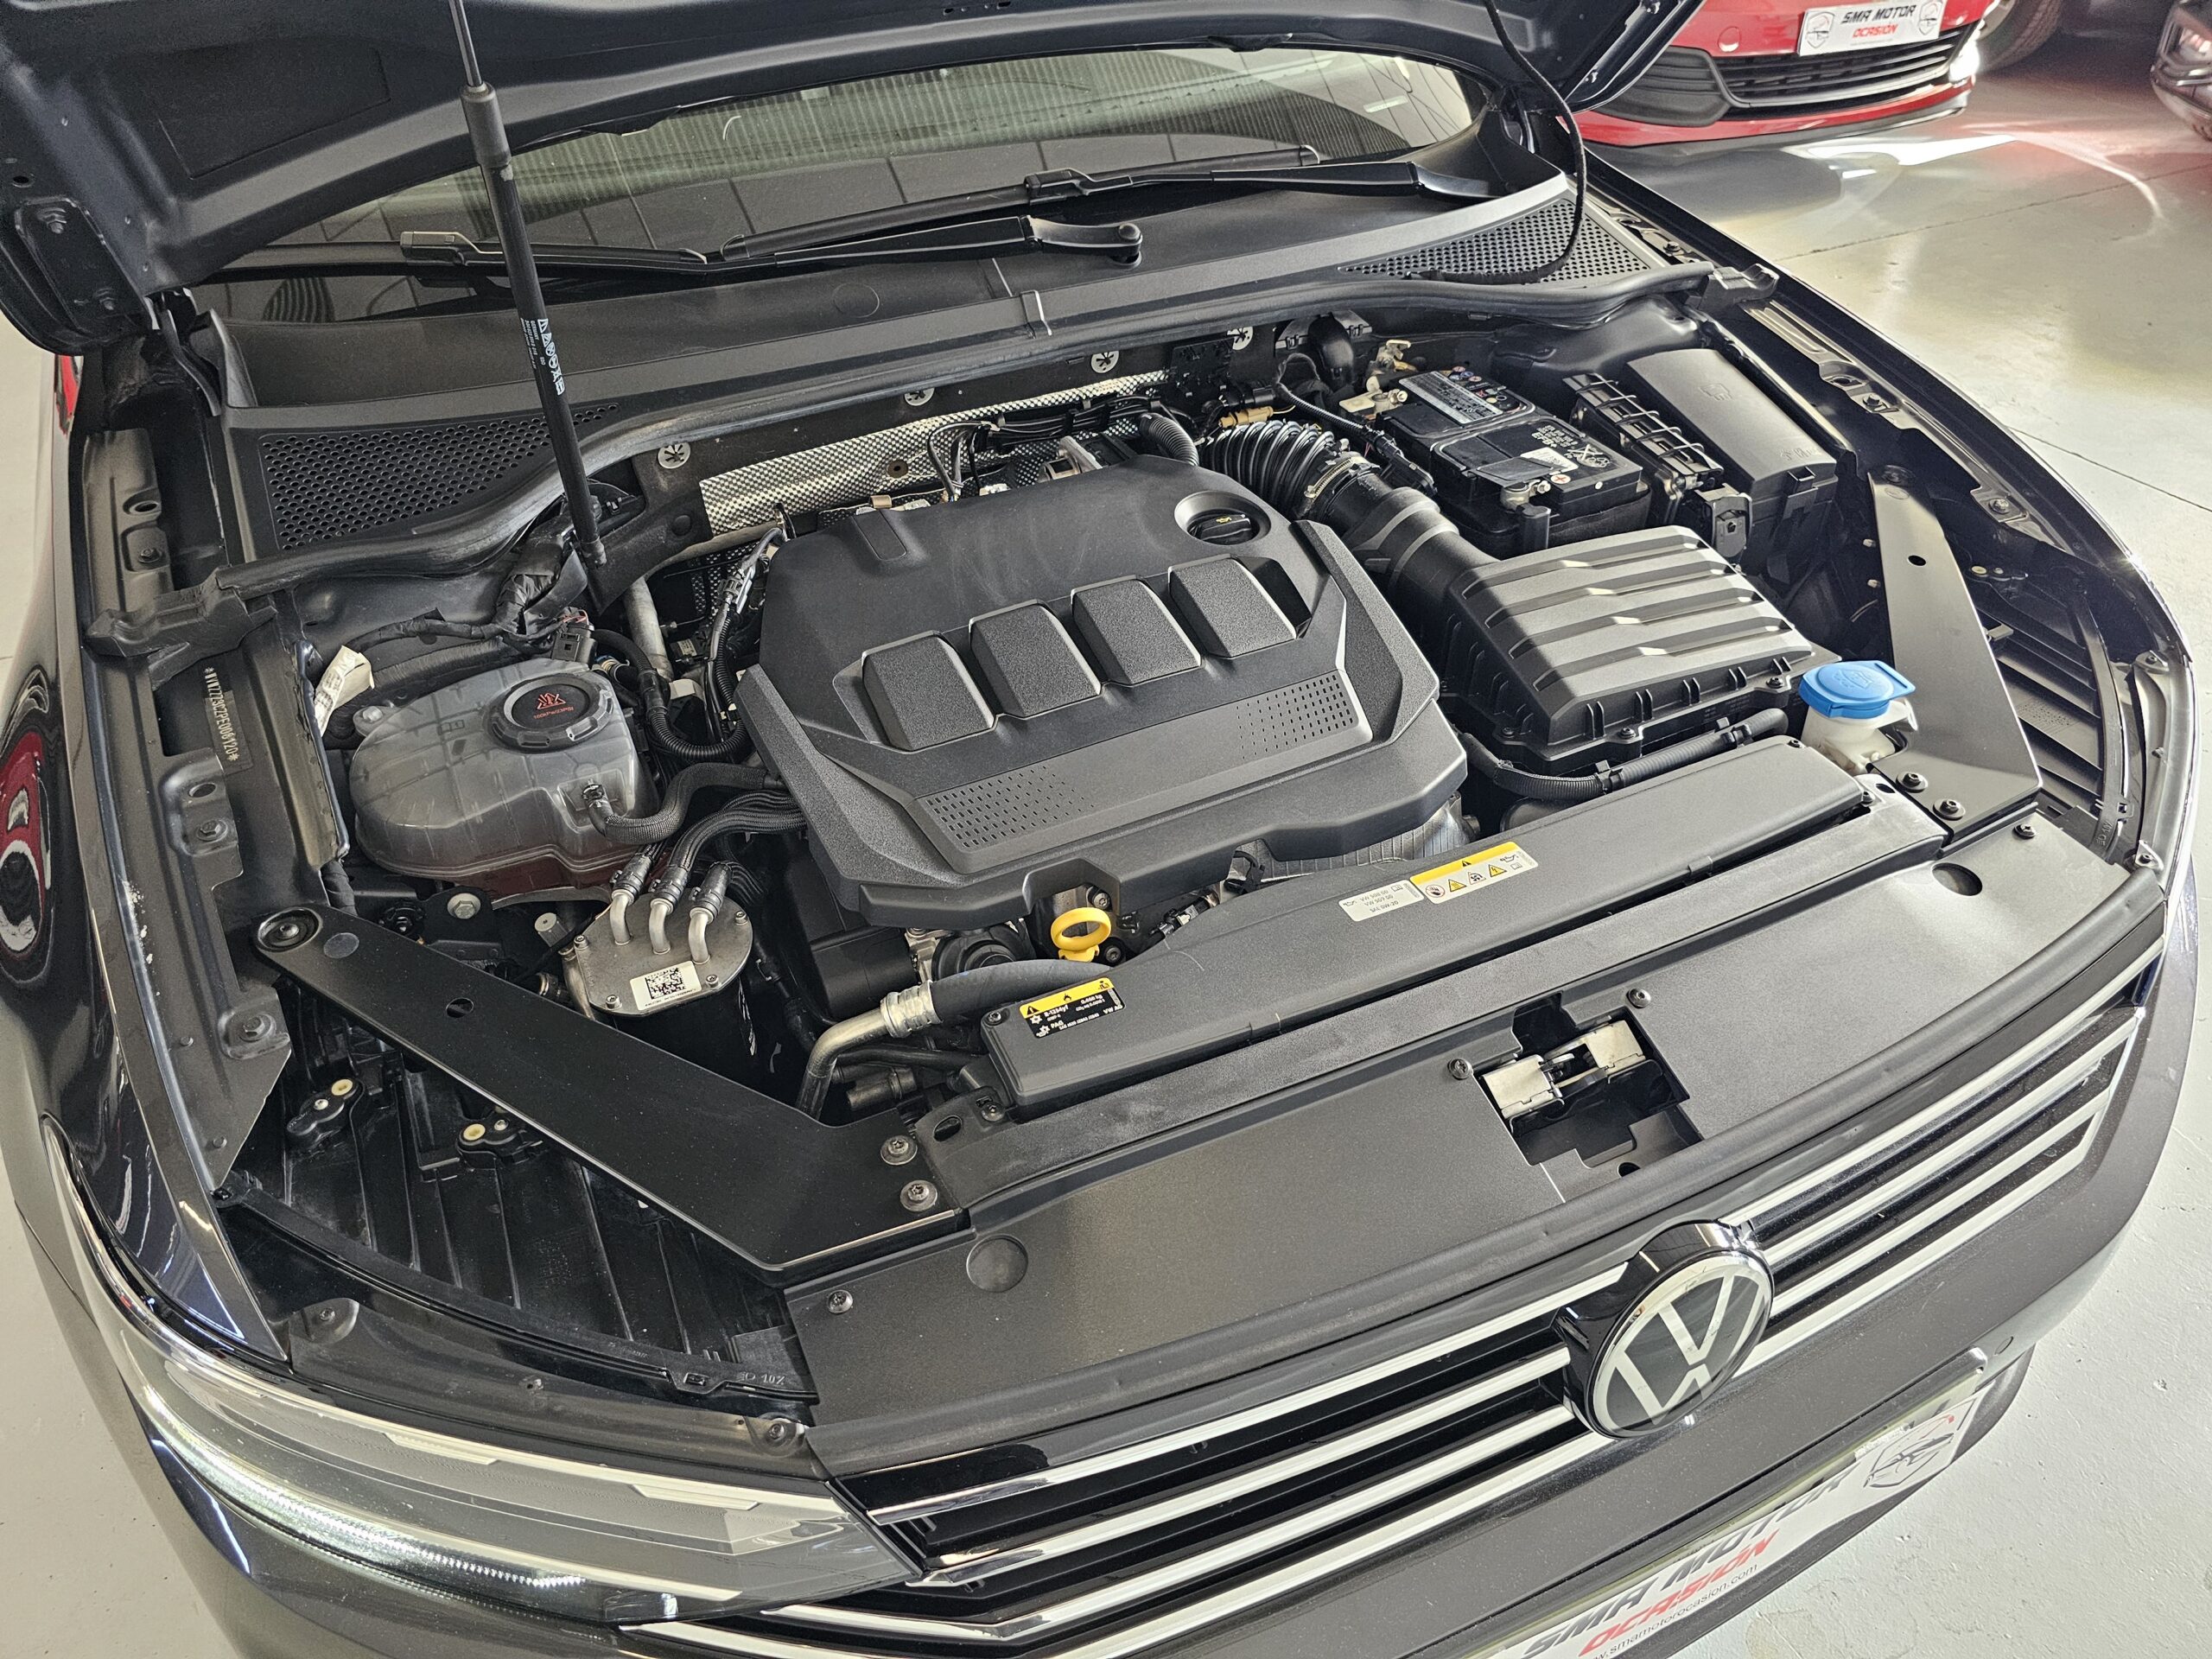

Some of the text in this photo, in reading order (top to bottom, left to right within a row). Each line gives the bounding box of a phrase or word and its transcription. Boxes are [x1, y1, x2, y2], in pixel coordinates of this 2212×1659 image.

[1840, 4, 1916, 24] SMA MOTOR
[1051, 1020, 1065, 1028] PAG
[761, 1373, 785, 1385] 10%
[1579, 1529, 1780, 1657] OCASIÓN
[1521, 1577, 1656, 1659] SMA
